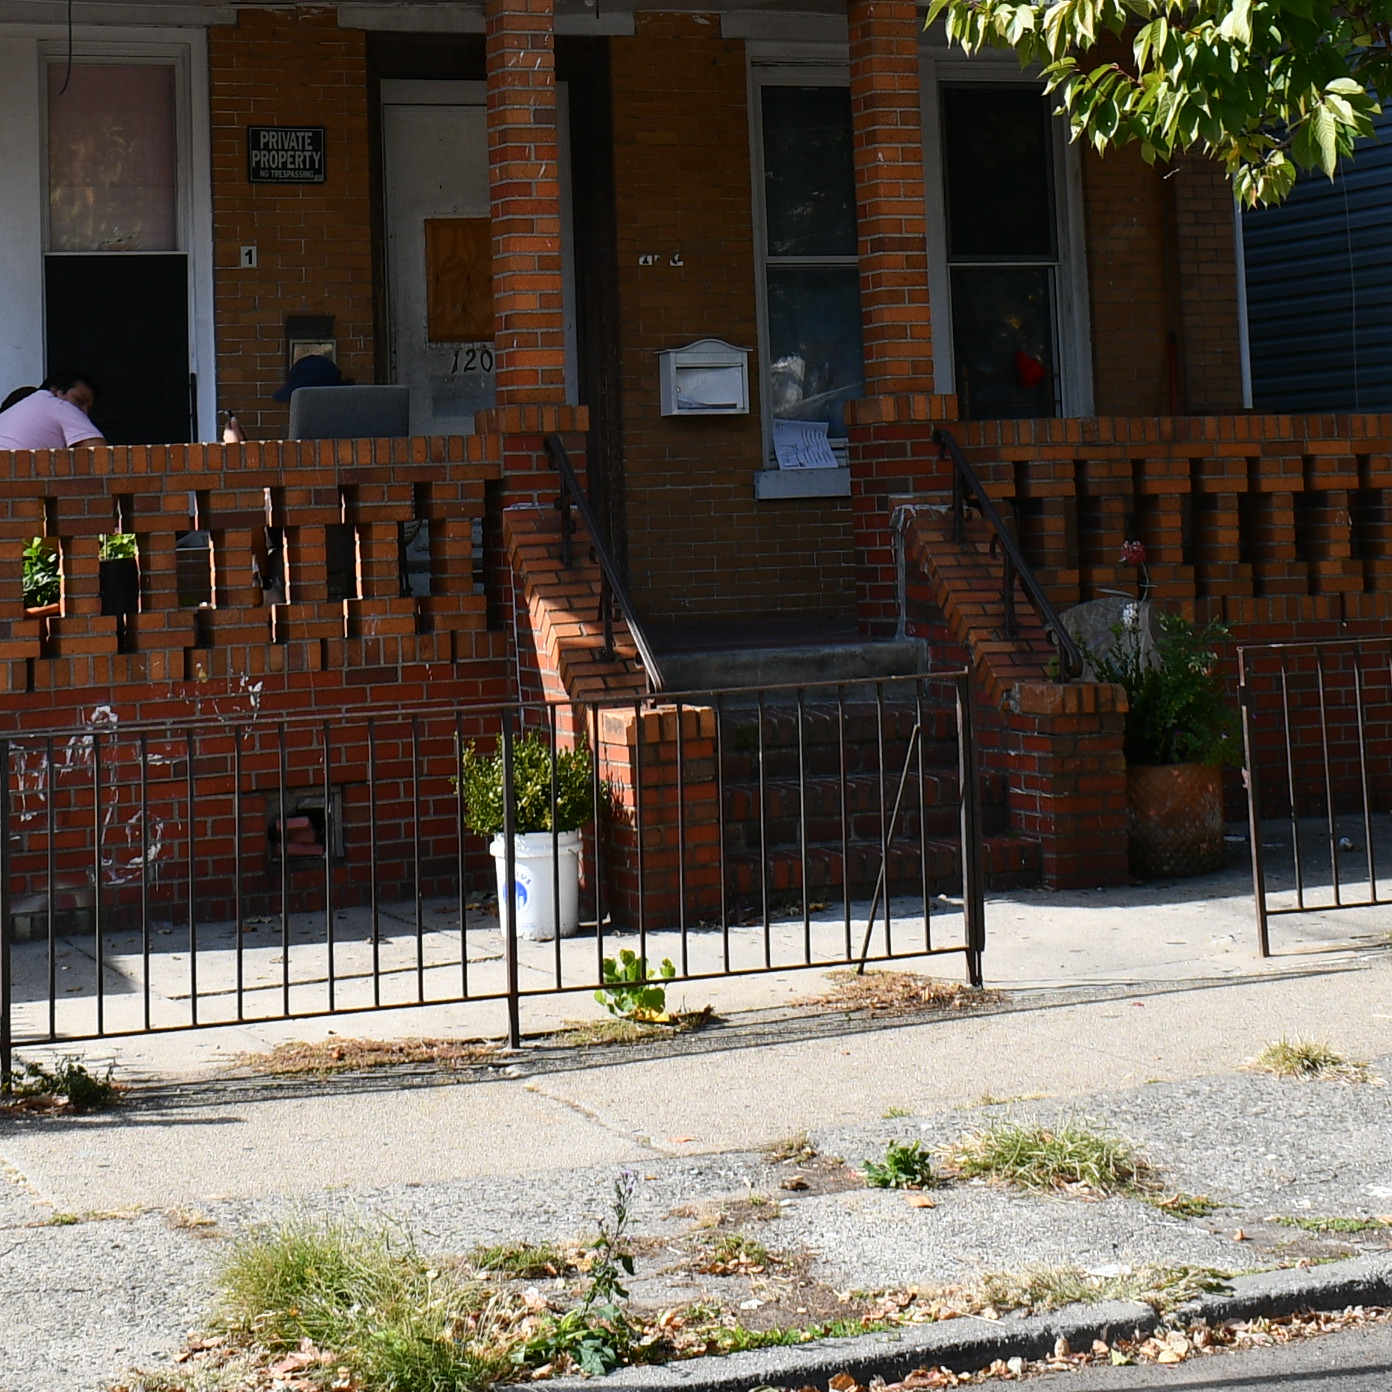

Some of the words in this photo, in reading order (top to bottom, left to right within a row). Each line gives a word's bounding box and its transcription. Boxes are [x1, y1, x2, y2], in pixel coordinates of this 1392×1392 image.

[260, 130, 313, 150] PRIVATE
[252, 149, 321, 169] PROPERTY
[260, 169, 269, 178] NO
[271, 169, 314, 179] TRESPASSING
[245, 248, 253, 265] 1
[451, 348, 494, 375] 120
